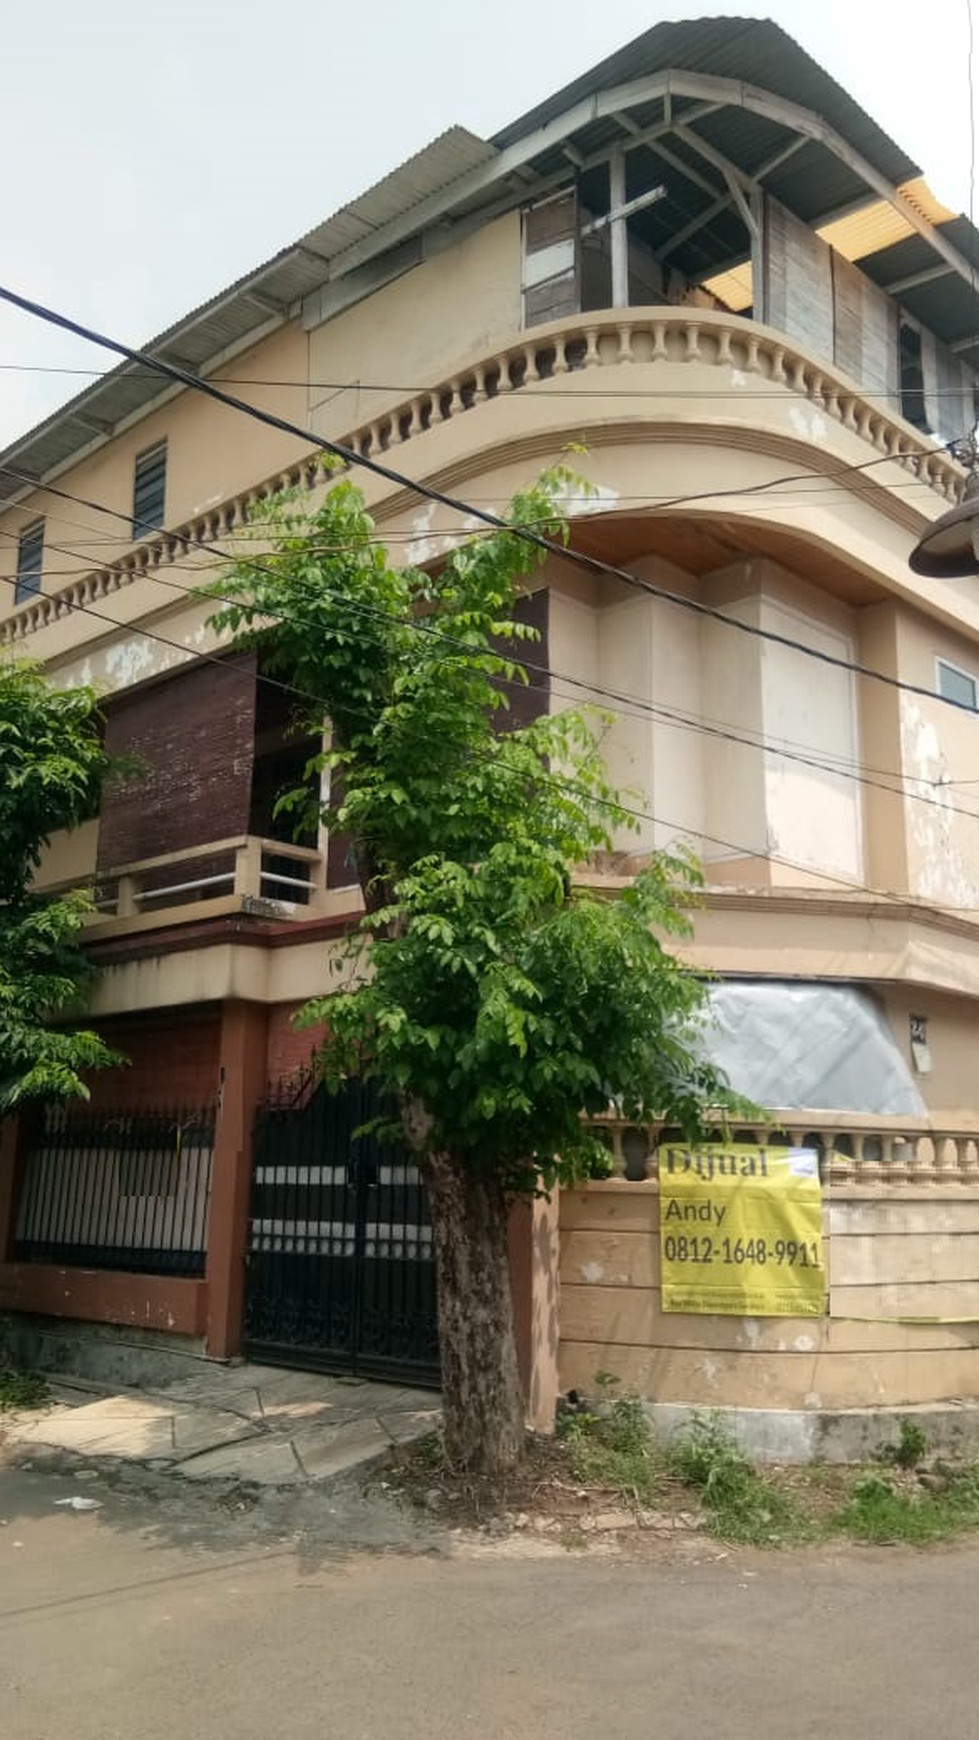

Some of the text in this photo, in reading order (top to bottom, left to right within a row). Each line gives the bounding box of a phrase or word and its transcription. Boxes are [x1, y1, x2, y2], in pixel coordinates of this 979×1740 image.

[666, 1147, 768, 1180] Dijual
[665, 1199, 726, 1227] Andy
[665, 1236, 820, 1268] 0812-1648-9911
